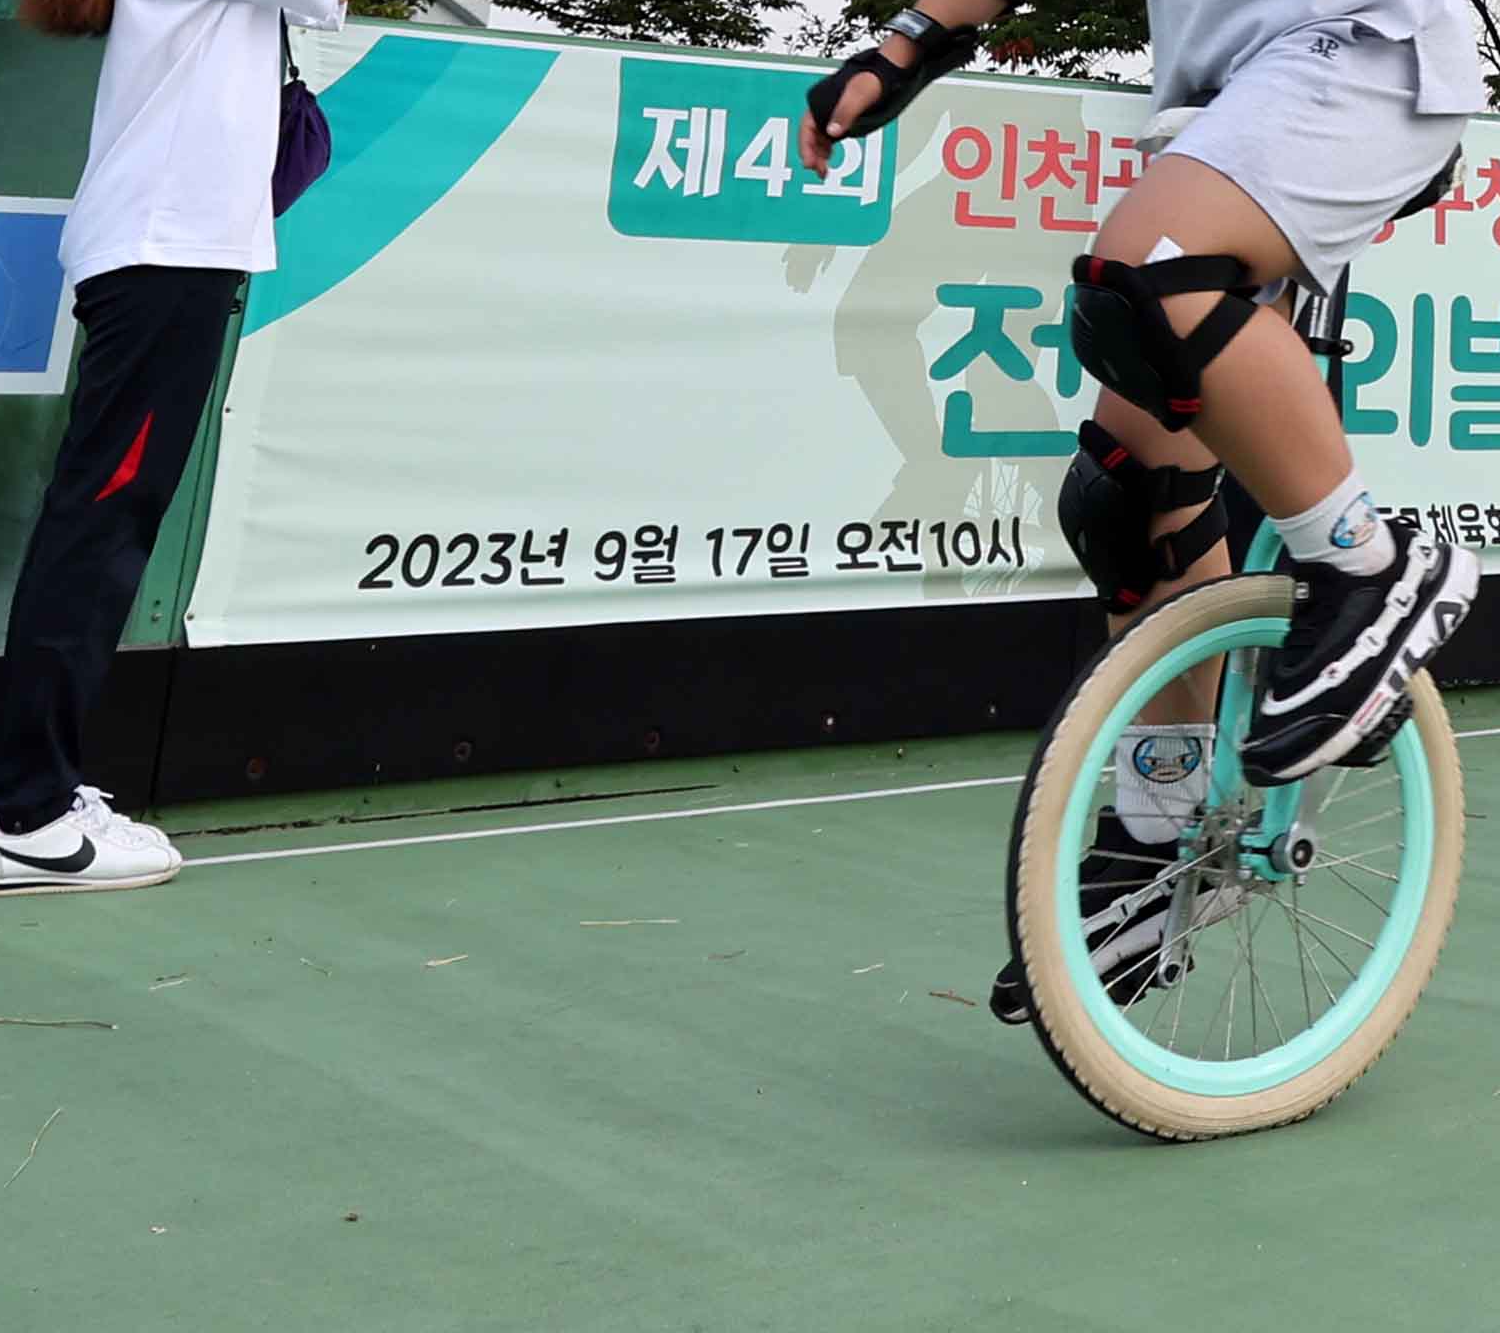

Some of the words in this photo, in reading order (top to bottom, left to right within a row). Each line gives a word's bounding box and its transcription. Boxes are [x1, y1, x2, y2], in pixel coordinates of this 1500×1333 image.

[929, 283, 1082, 458] 전
[358, 527, 569, 590] 2023년
[594, 524, 679, 584] 9월
[705, 521, 810, 578] 17일
